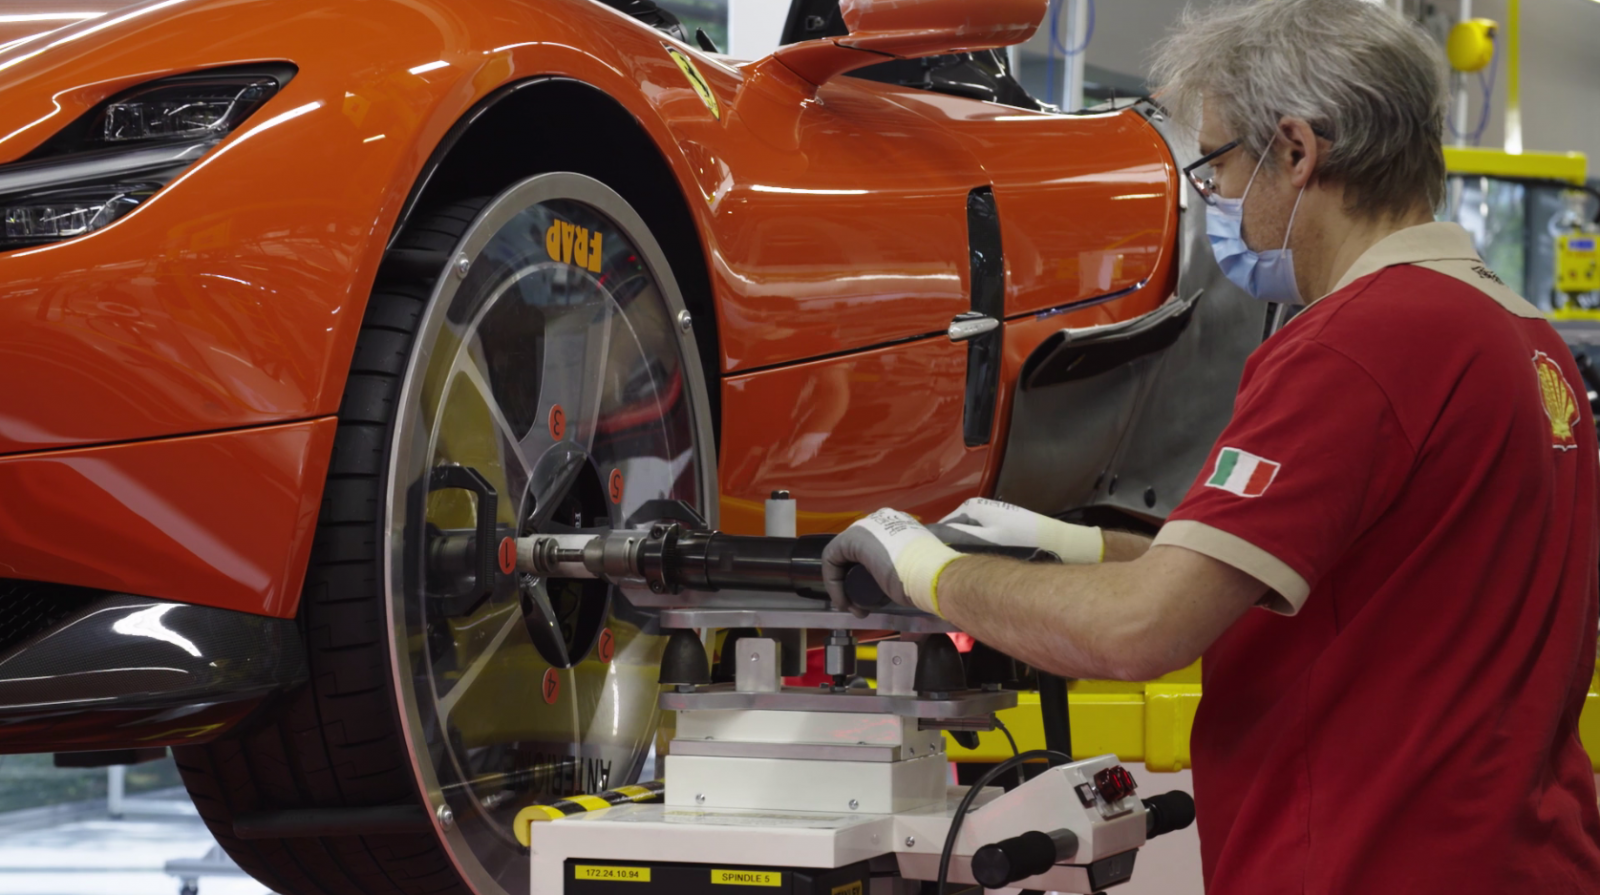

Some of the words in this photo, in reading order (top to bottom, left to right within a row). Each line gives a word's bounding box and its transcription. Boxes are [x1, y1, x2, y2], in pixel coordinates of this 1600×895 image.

[546, 219, 602, 274] FRAP
[554, 410, 562, 436] 3
[613, 474, 621, 499] 5
[603, 632, 611, 659] 2
[547, 673, 557, 698] 4
[586, 869, 639, 879] 172.24.10.94
[722, 873, 762, 883] SPINDLE
[764, 875, 770, 883] 5
